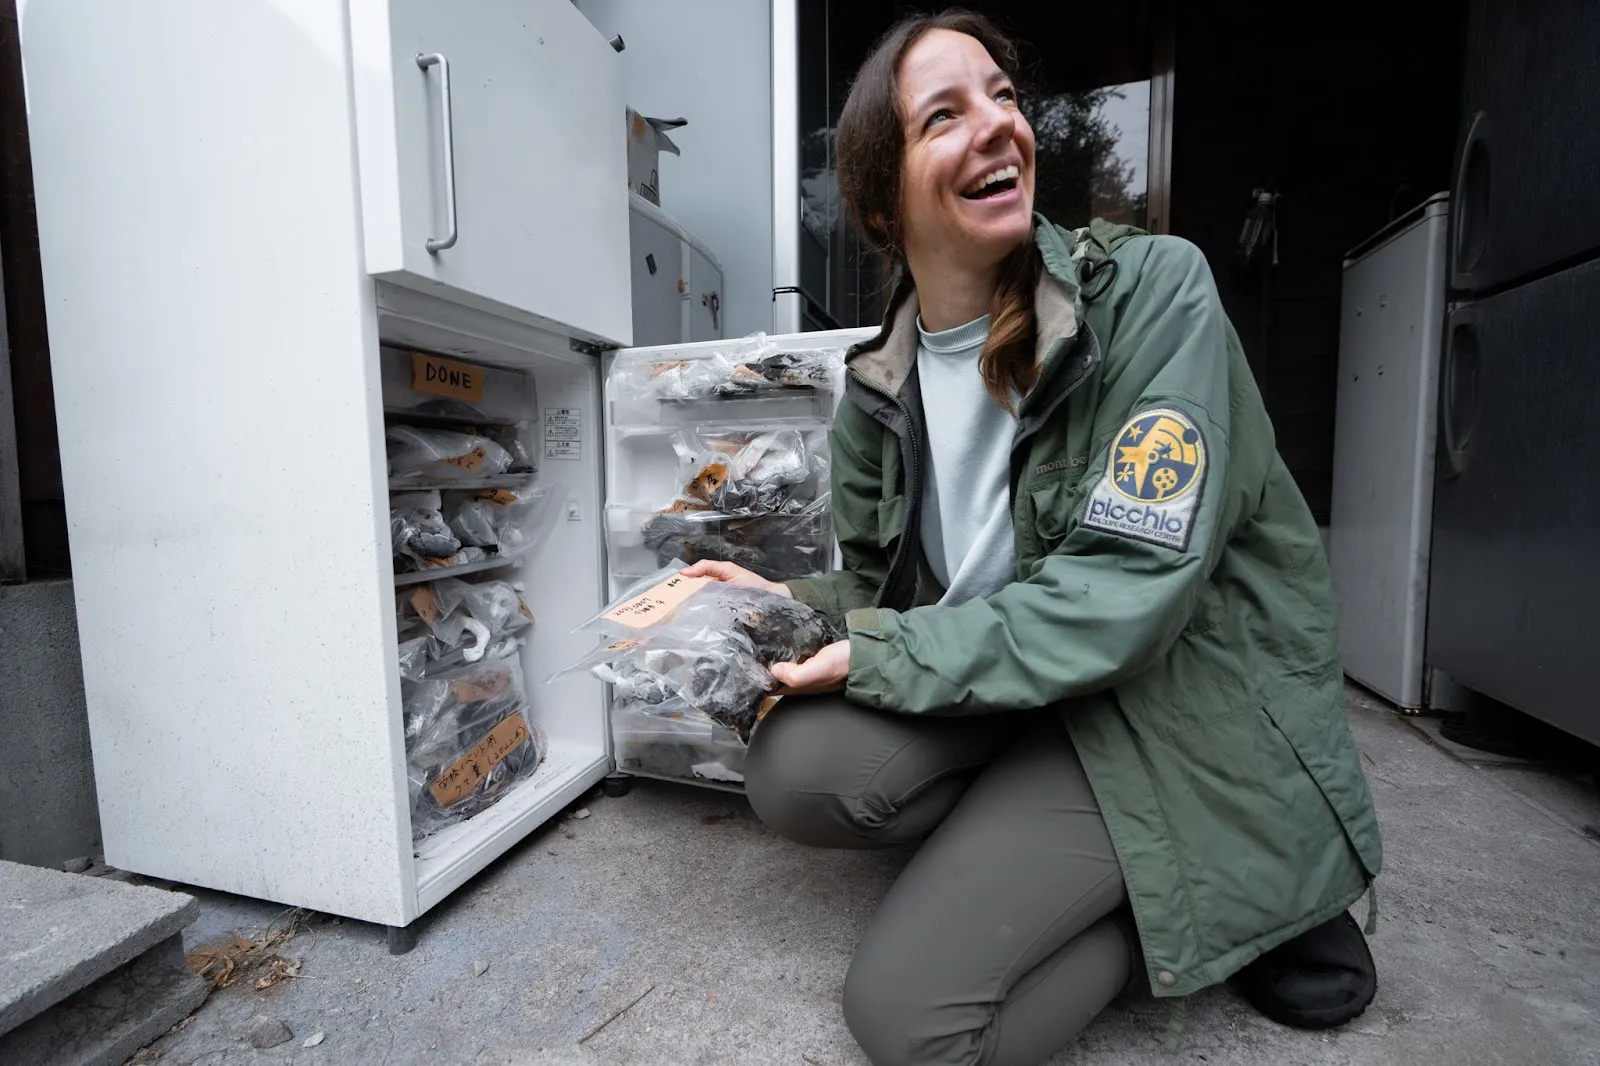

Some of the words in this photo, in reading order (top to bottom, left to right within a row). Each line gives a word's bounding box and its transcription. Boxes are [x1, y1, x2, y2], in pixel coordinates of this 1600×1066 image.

[425, 361, 472, 389] DONE
[1089, 497, 1182, 533] picchio
[1119, 523, 1154, 536] RESEARCH
[1154, 529, 1182, 542] CENTER
